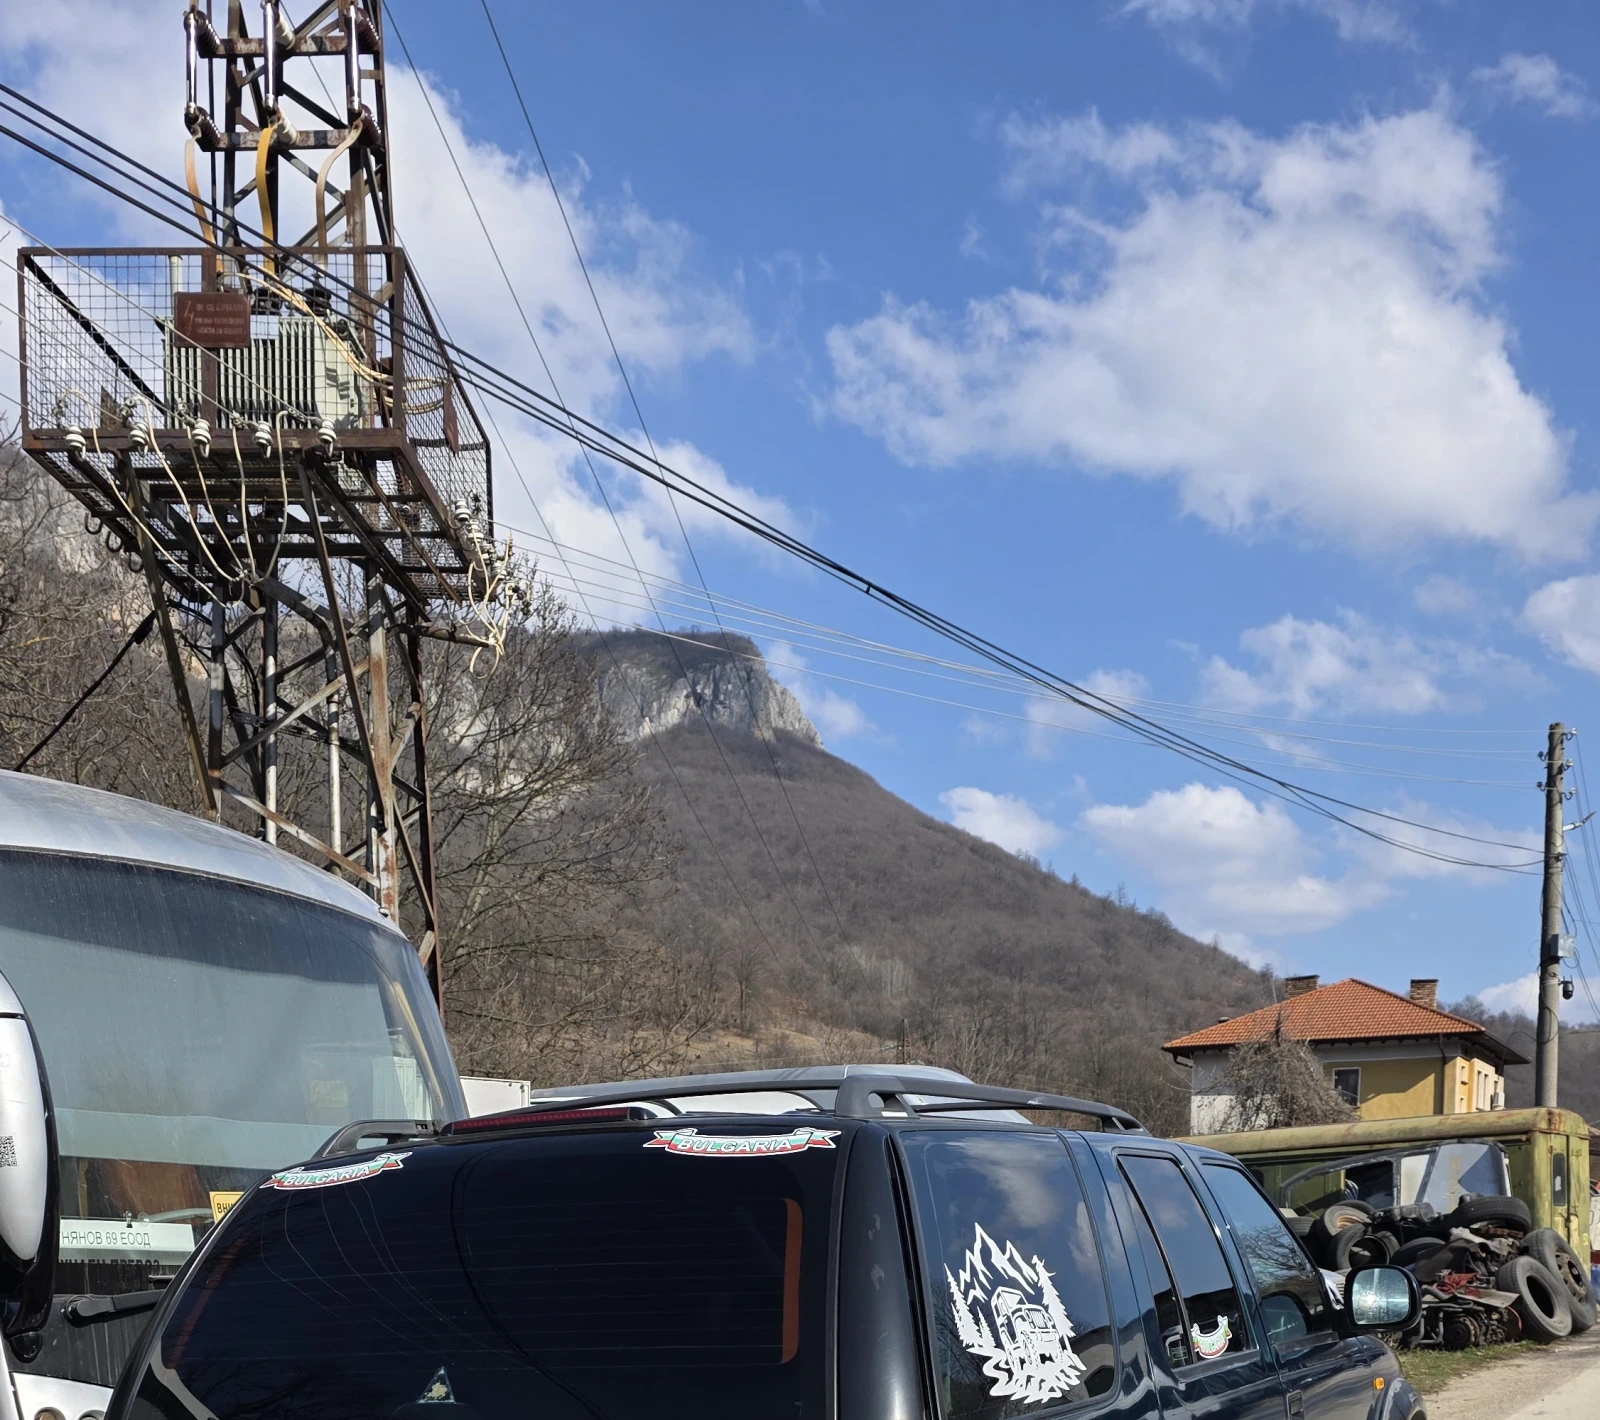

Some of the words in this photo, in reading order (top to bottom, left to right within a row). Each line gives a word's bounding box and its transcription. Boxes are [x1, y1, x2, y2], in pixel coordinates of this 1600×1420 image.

[677, 1138, 792, 1153] BULGARIA
[283, 1165, 371, 1186] BULGARIA
[60, 1231, 103, 1245] НЯНОВ
[106, 1231, 118, 1245] 69
[121, 1232, 151, 1248] ЕООД
